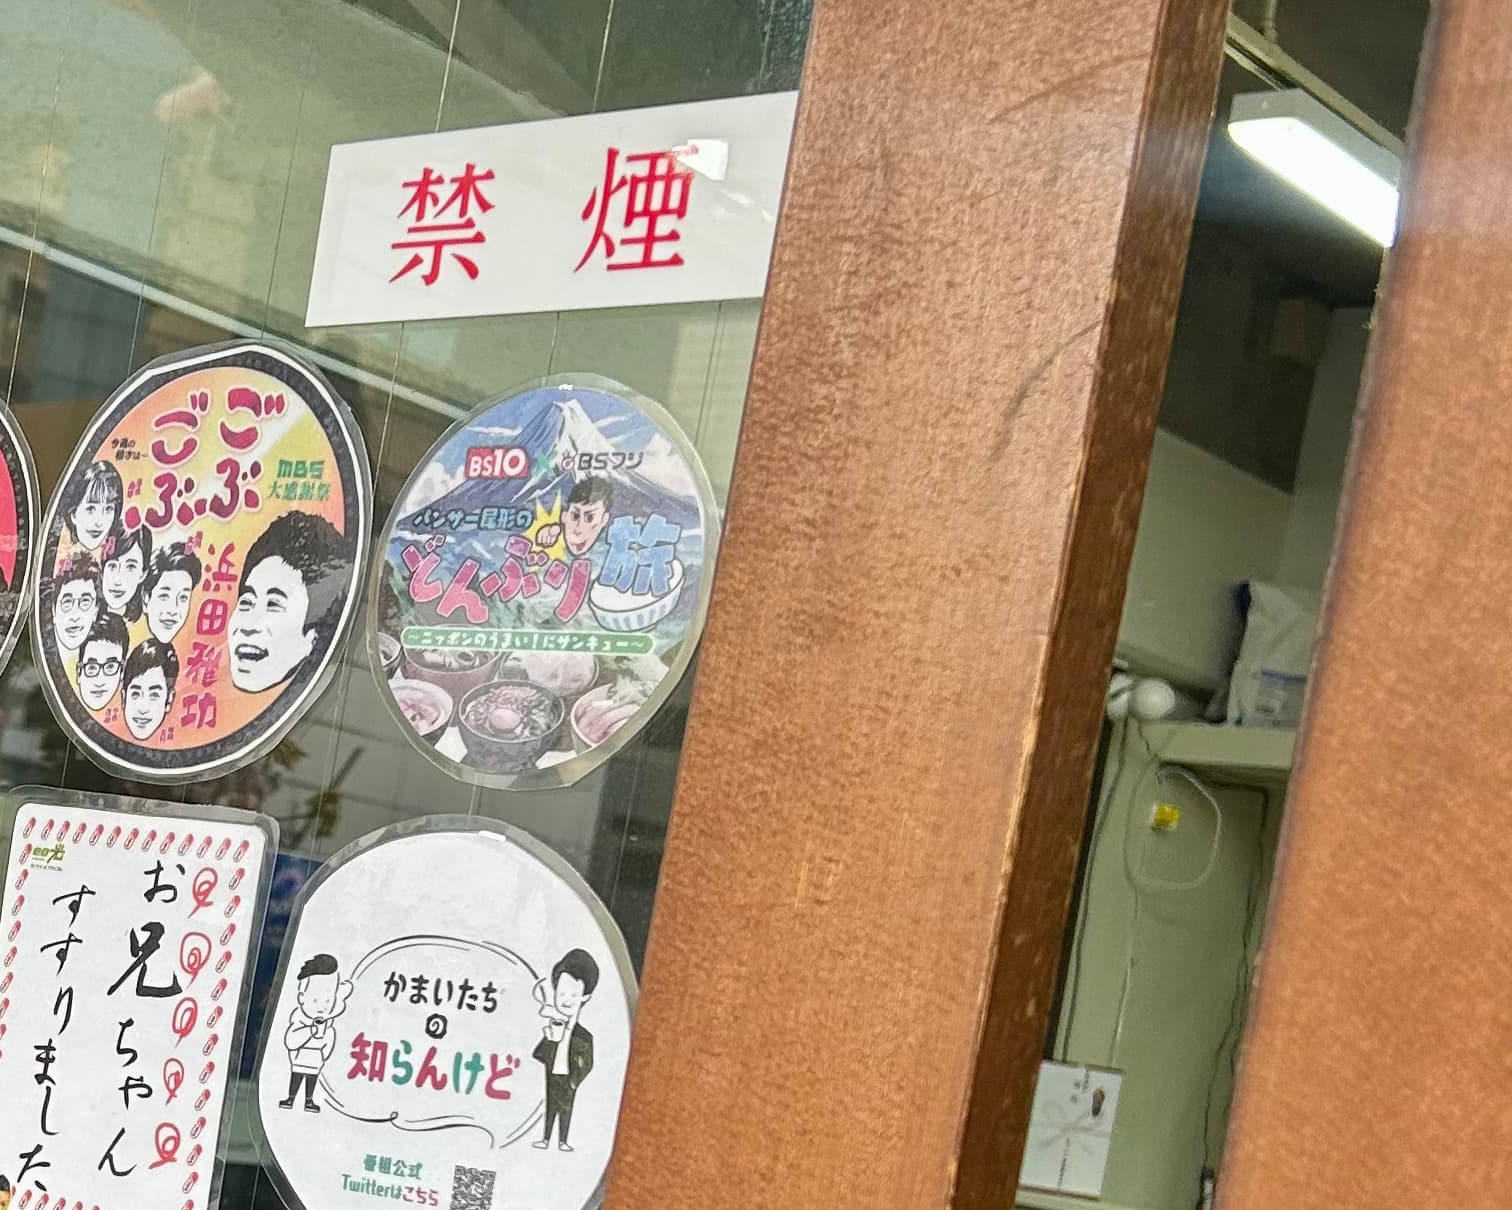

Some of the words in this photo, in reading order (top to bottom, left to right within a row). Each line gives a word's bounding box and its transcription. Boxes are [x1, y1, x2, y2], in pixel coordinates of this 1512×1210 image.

[389, 144, 699, 286] 禁煙
[468, 449, 527, 478] BS10
[414, 507, 533, 530] パンサー尾形の
[401, 534, 590, 624] どんぶり
[599, 514, 681, 596] 旅
[98, 860, 186, 1177] お兄ちゃん
[383, 971, 499, 1013] かまいたち
[17, 885, 96, 1191] すすりました
[347, 1032, 521, 1100] 知らんけど
[341, 1173, 439, 1207] Twitterはこちら
[363, 1154, 423, 1180] 番組公式
